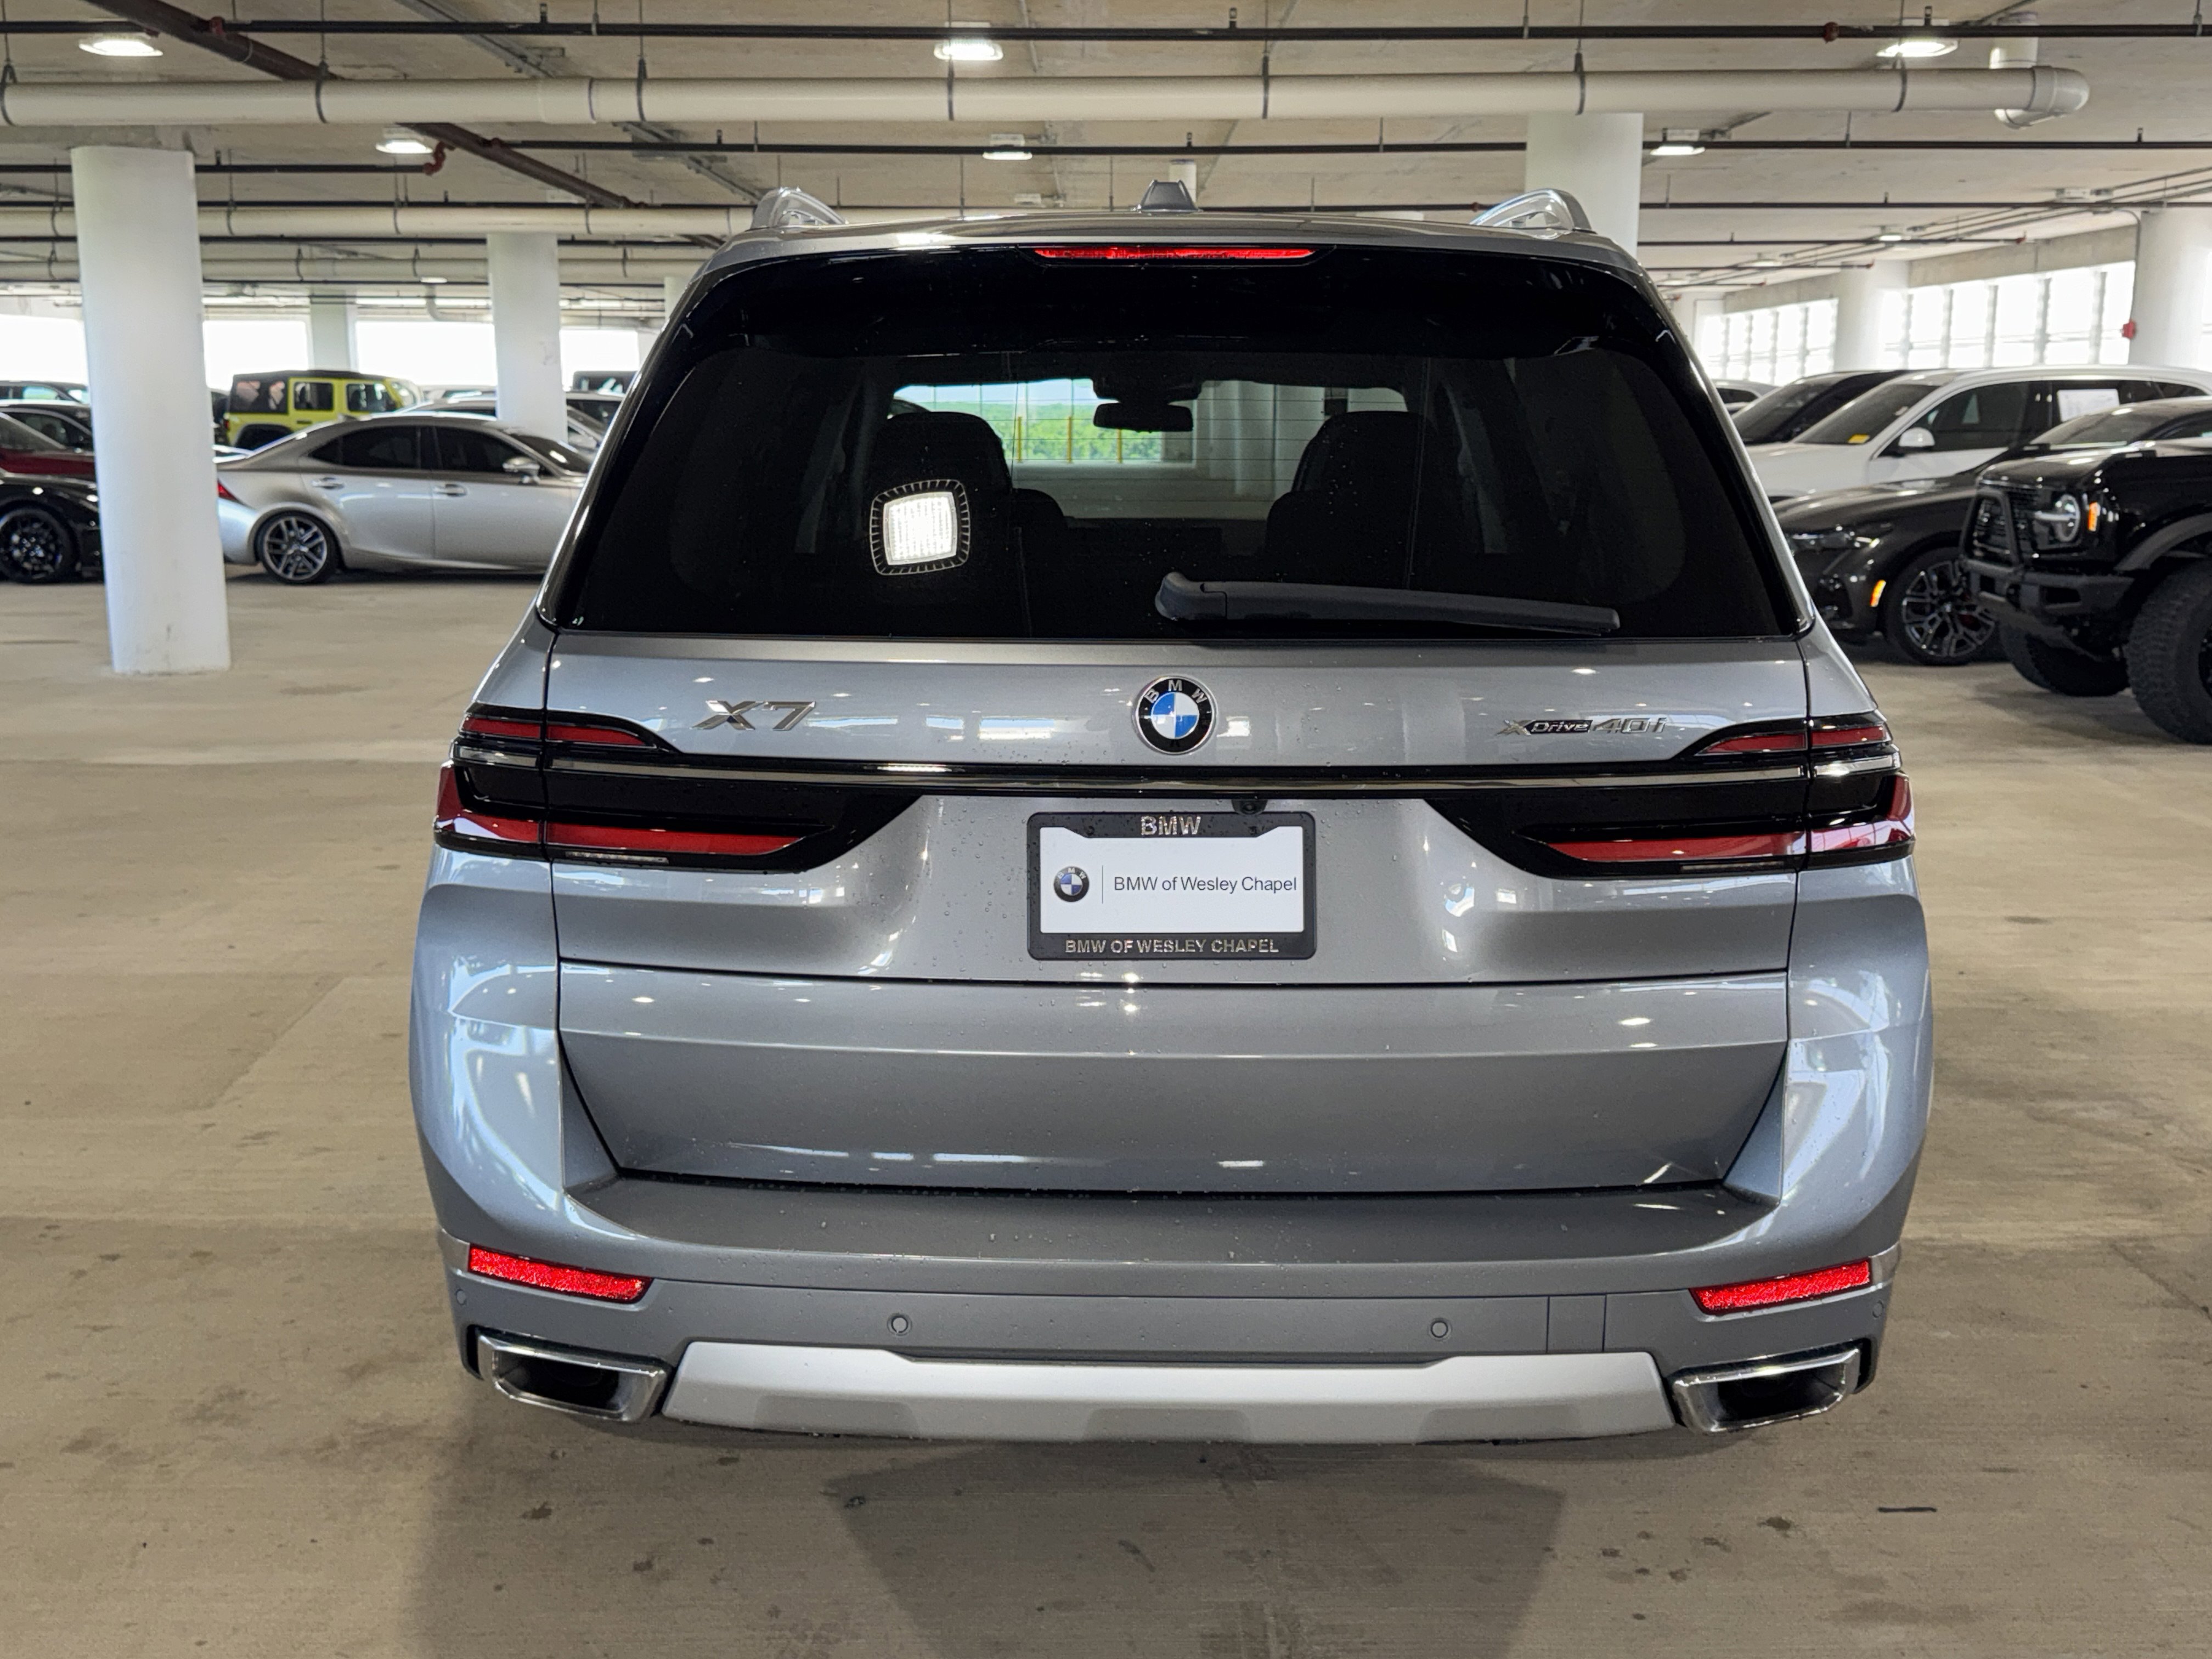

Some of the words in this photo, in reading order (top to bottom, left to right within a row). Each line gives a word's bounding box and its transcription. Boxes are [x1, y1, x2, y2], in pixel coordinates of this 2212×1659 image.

[1144, 680, 1207, 704] BMW
[691, 700, 816, 730] X7
[1141, 816, 1201, 835] BMW
[1057, 867, 1087, 879] BMW
[1114, 877, 1158, 890] BMW
[1162, 877, 1178, 891] of
[1181, 877, 1238, 894] Wesley
[1242, 876, 1297, 893] Chapel
[1065, 940, 1106, 953] BMW
[1110, 940, 1134, 953] OF
[1136, 940, 1207, 953] WESLEY
[1211, 939, 1279, 953] CHAPEL
